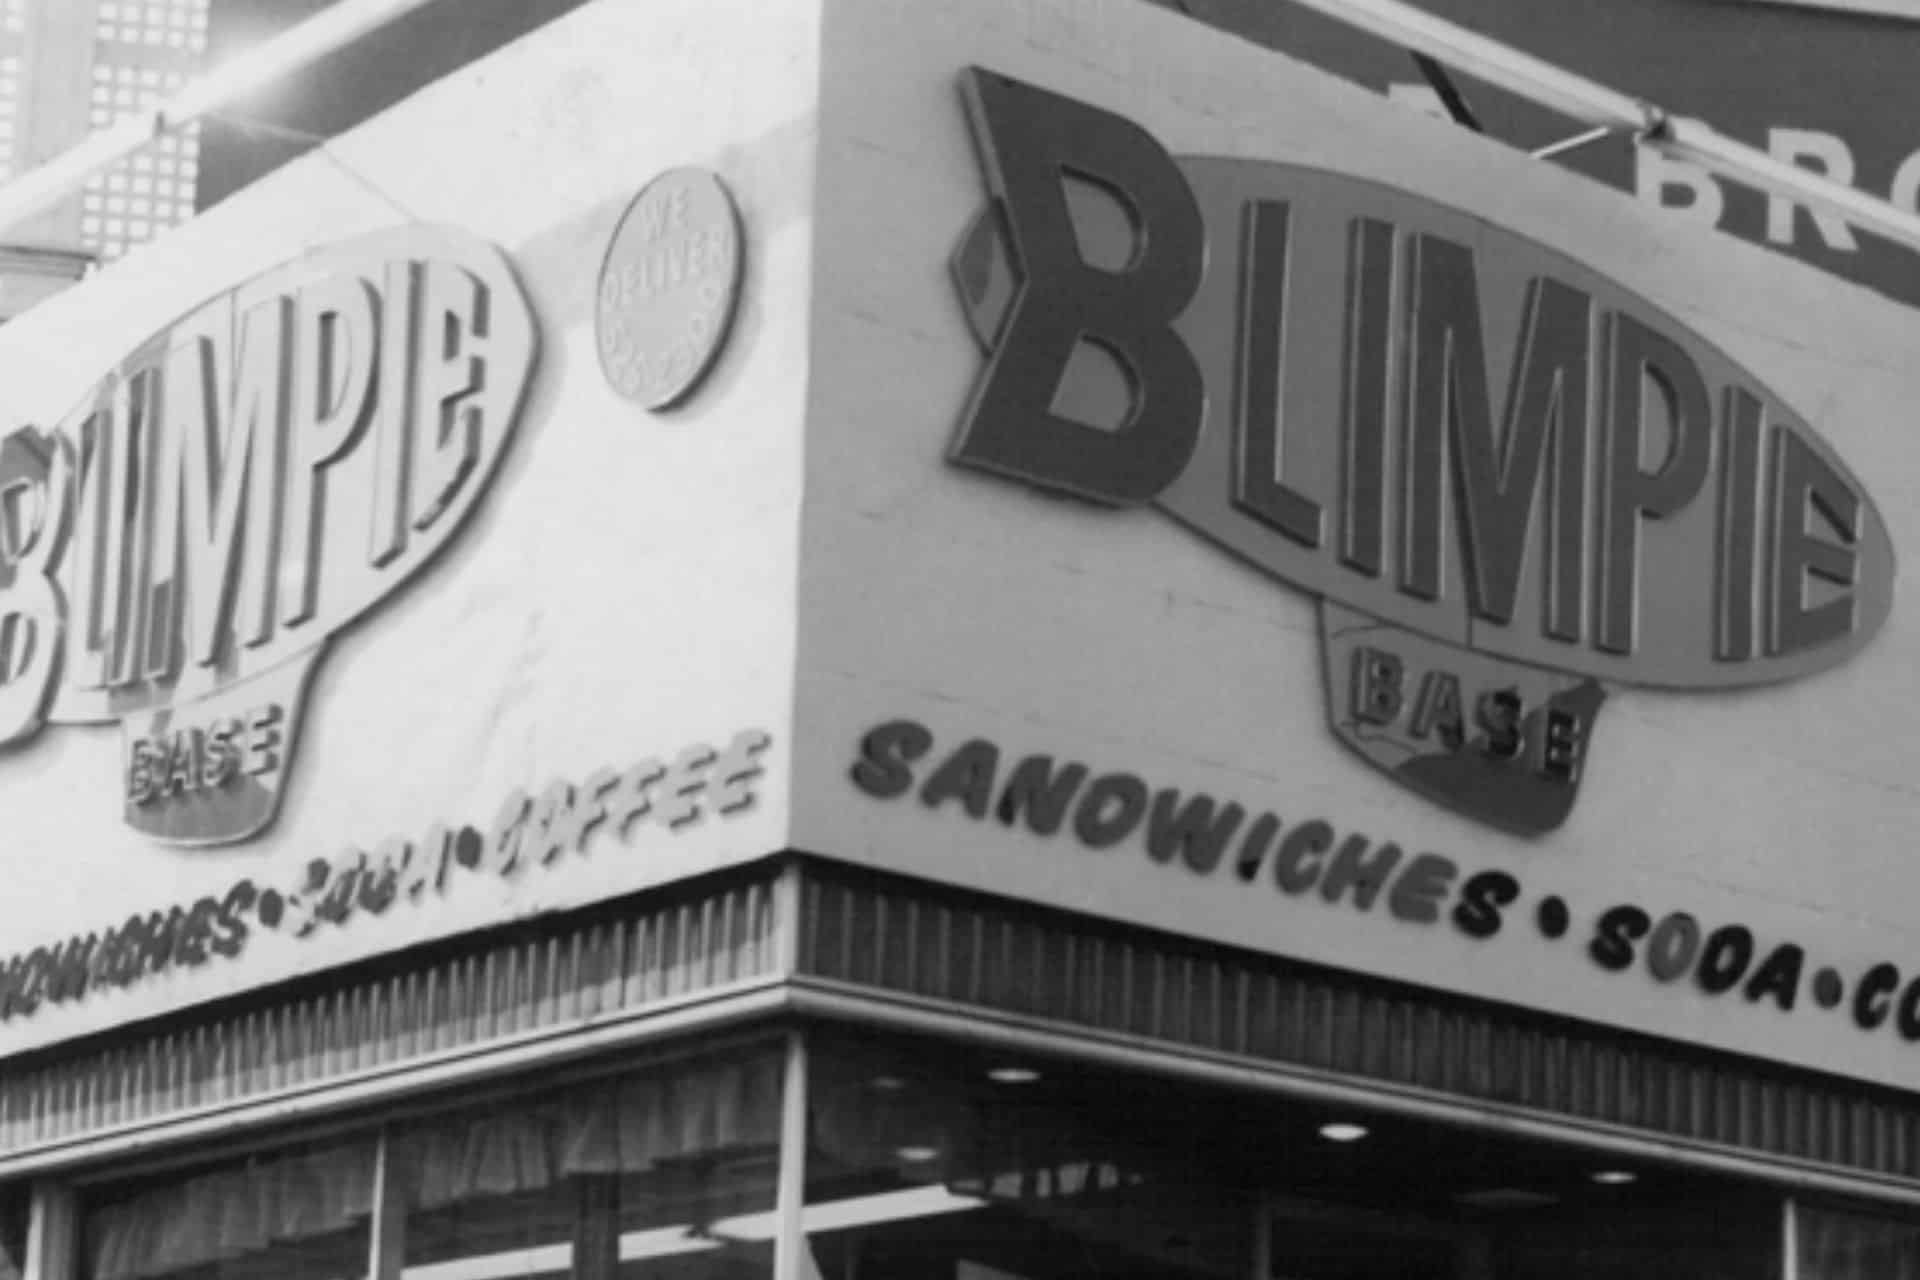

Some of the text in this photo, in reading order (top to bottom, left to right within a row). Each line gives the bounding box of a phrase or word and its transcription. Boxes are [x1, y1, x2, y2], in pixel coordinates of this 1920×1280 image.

[946, 65, 1864, 666] BLIMPIE
[128, 704, 284, 806] BASE
[1350, 646, 1582, 785] BASE
[493, 730, 773, 878] COFFEE
[1587, 904, 1807, 1012] SODA
